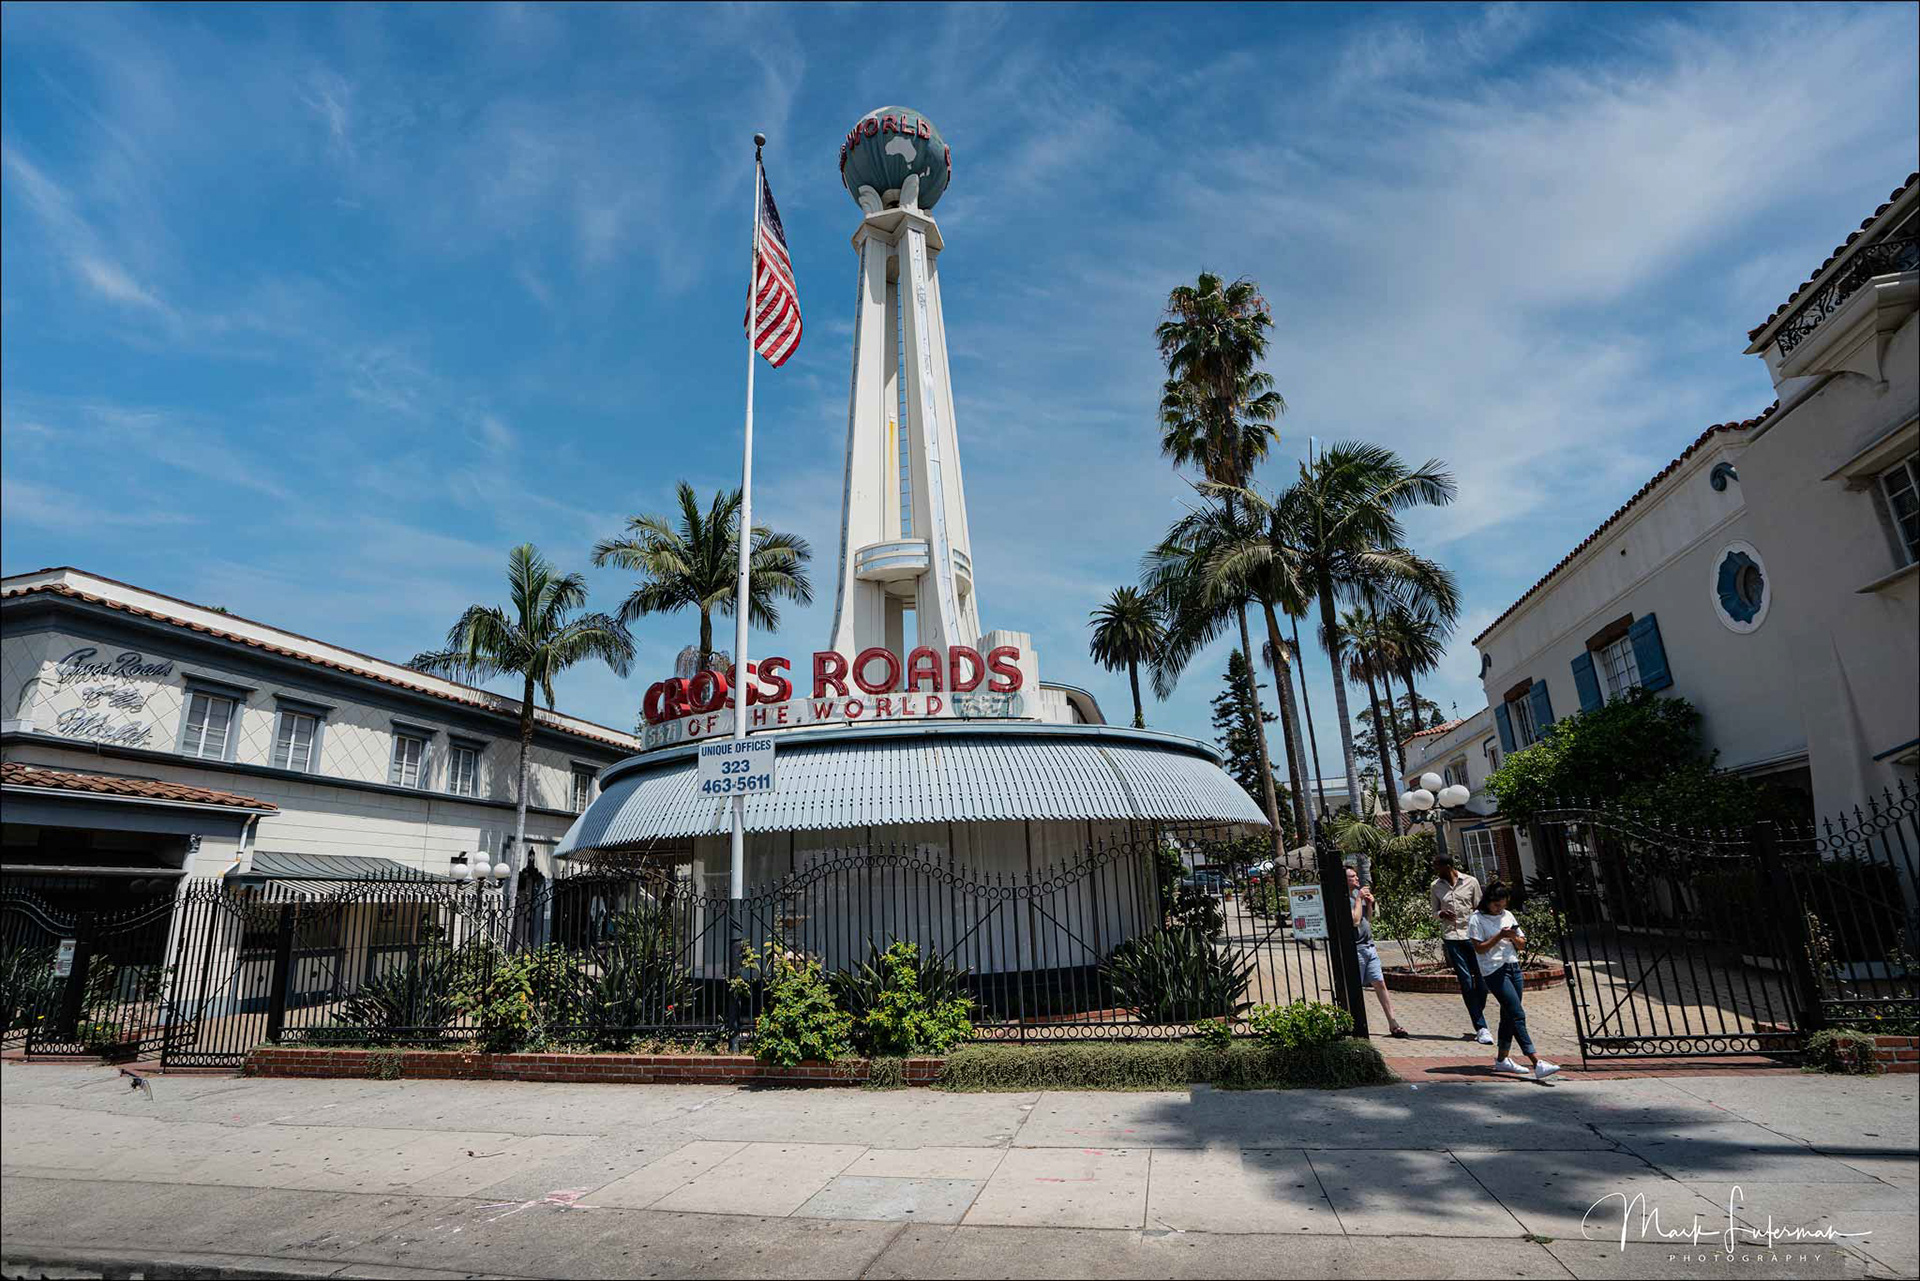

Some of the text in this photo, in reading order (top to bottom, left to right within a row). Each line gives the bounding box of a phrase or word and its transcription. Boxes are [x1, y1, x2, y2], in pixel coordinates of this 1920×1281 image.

[846, 114, 931, 150] WORLD
[643, 645, 1024, 726] CROSS ROADS
[688, 714, 719, 736] OF
[752, 705, 789, 727] HE
[814, 695, 943, 719] WORLD
[701, 739, 772, 757] UNIQUE OFFICES
[721, 759, 750, 774] 323
[702, 774, 771, 794] 463-5611
